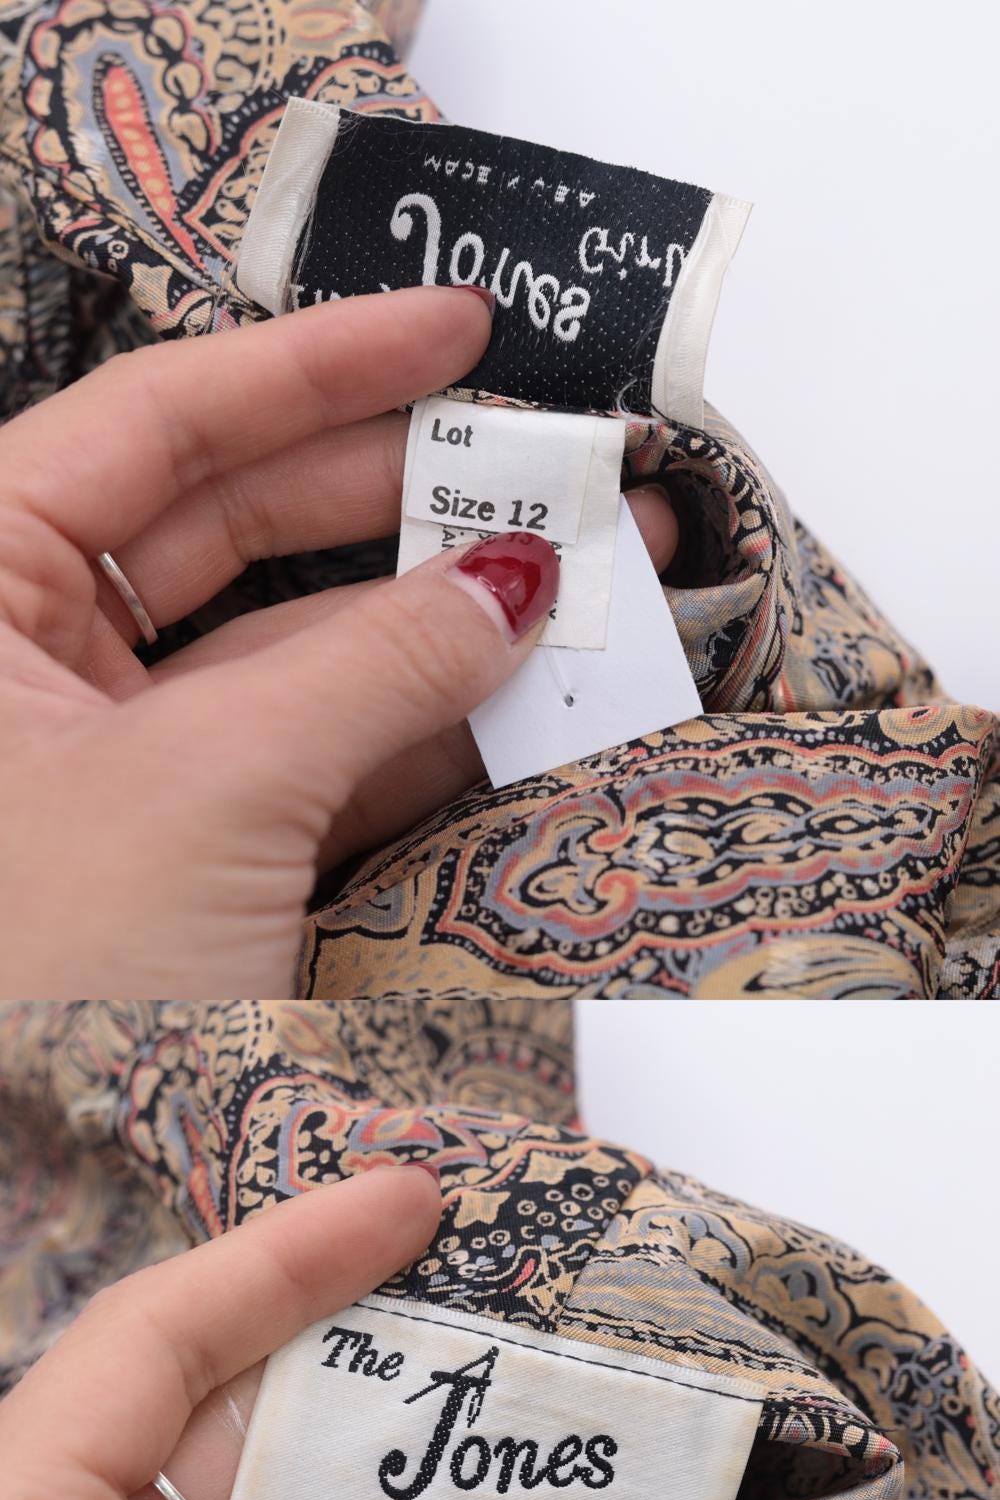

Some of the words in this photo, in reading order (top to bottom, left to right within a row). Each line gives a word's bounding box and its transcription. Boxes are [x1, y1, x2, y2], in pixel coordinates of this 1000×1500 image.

[430, 418, 474, 448] Lot
[430, 486, 496, 522] Size
[507, 500, 549, 530] 12
[320, 1327, 405, 1381] The
